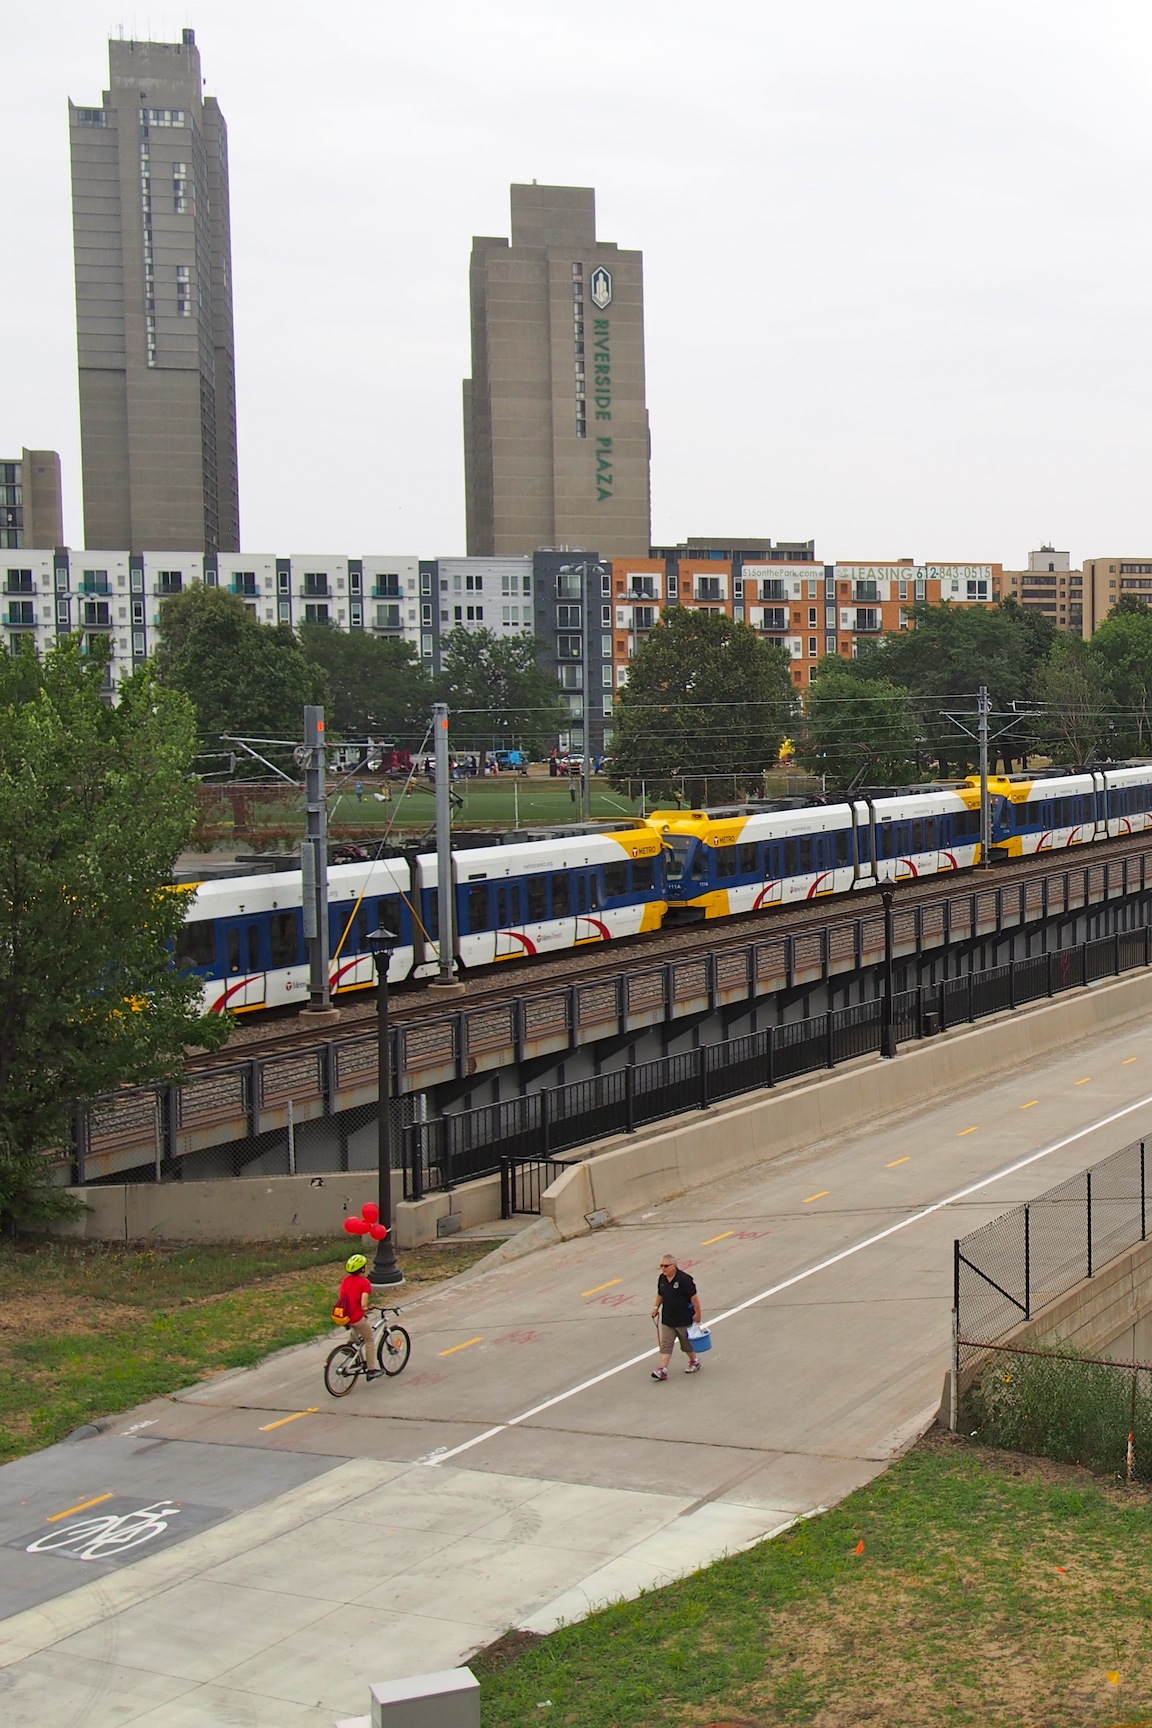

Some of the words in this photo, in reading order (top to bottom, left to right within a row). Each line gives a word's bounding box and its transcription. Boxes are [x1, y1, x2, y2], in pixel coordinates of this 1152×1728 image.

[593, 319, 612, 421] RIVERSIDE
[595, 436, 613, 502] PLAZA
[742, 568, 818, 578] 515onthePark.com
[851, 567, 913, 581] LEASING
[719, 836, 735, 845] METRO
[639, 846, 656, 855] METRO
